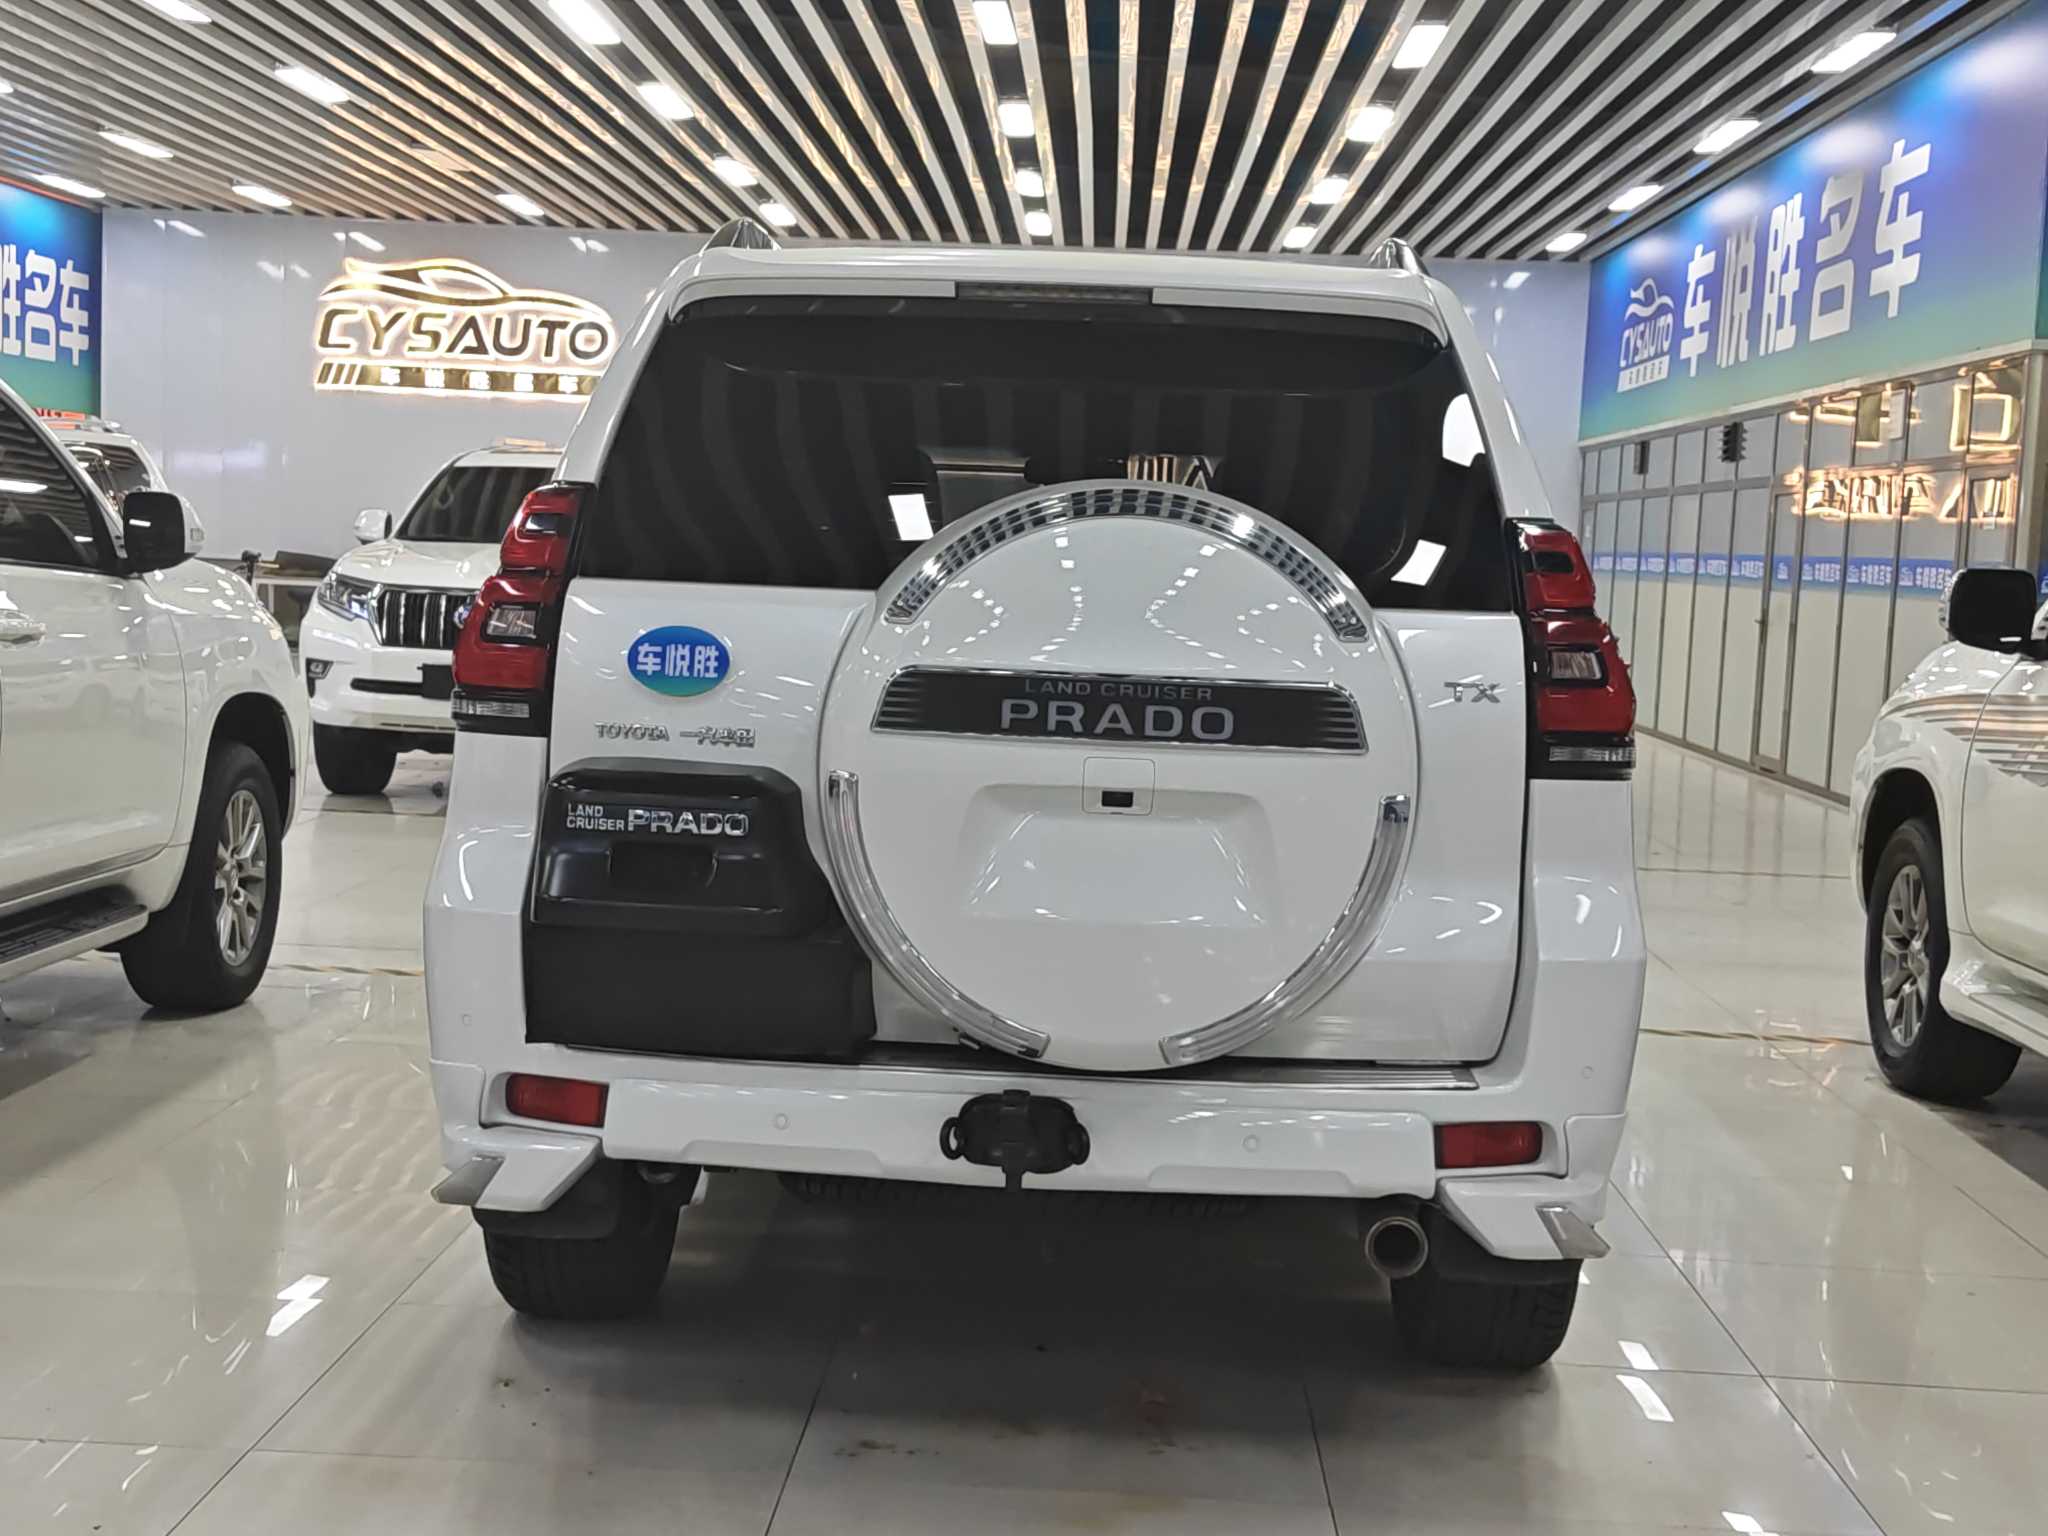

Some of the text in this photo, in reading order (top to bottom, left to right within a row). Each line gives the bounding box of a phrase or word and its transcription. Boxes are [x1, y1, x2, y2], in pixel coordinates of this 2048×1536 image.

[1680, 138, 1931, 377] 车悦胜名车
[317, 306, 609, 360] CYSAUTO
[1620, 312, 1674, 368] CYSAUTO
[636, 642, 719, 679] 车悦胜
[1024, 678, 1213, 701] LAND CRUISER
[1443, 681, 1501, 703] TX
[594, 722, 669, 742] TOYOTA
[1000, 698, 1235, 741] PRADO
[566, 815, 625, 832] CRUISER
[567, 803, 604, 818] LAND
[626, 808, 751, 837] PRADO
